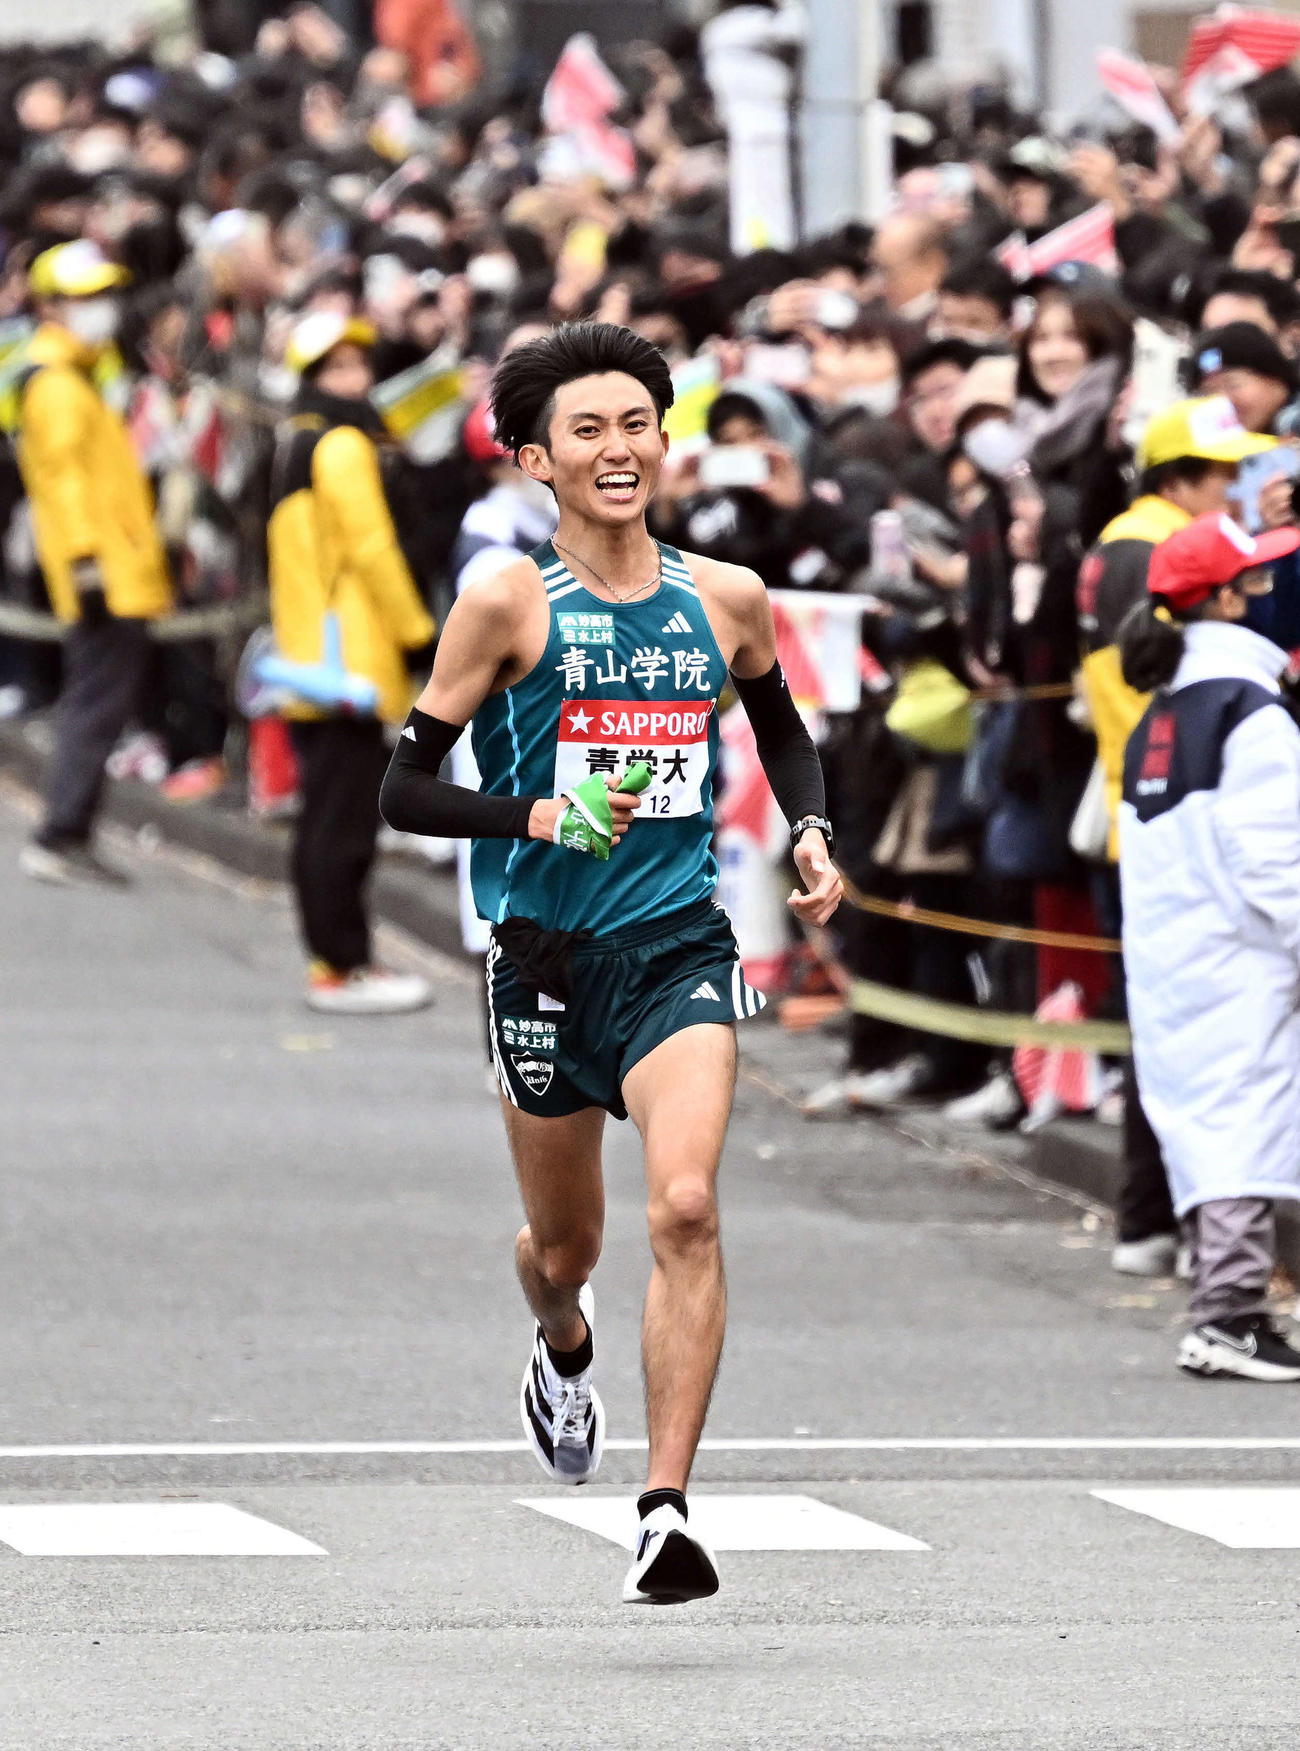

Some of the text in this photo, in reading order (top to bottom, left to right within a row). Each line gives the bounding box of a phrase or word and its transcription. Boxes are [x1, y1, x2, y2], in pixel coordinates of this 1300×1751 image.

[578, 614, 613, 627] 妙高市
[577, 630, 613, 643] 水上村
[555, 646, 711, 691] 青山学院
[600, 711, 706, 736] SAPPORO
[650, 795, 671, 814] 12
[518, 1019, 557, 1034] 妙高市
[517, 1035, 556, 1049] 水上村
